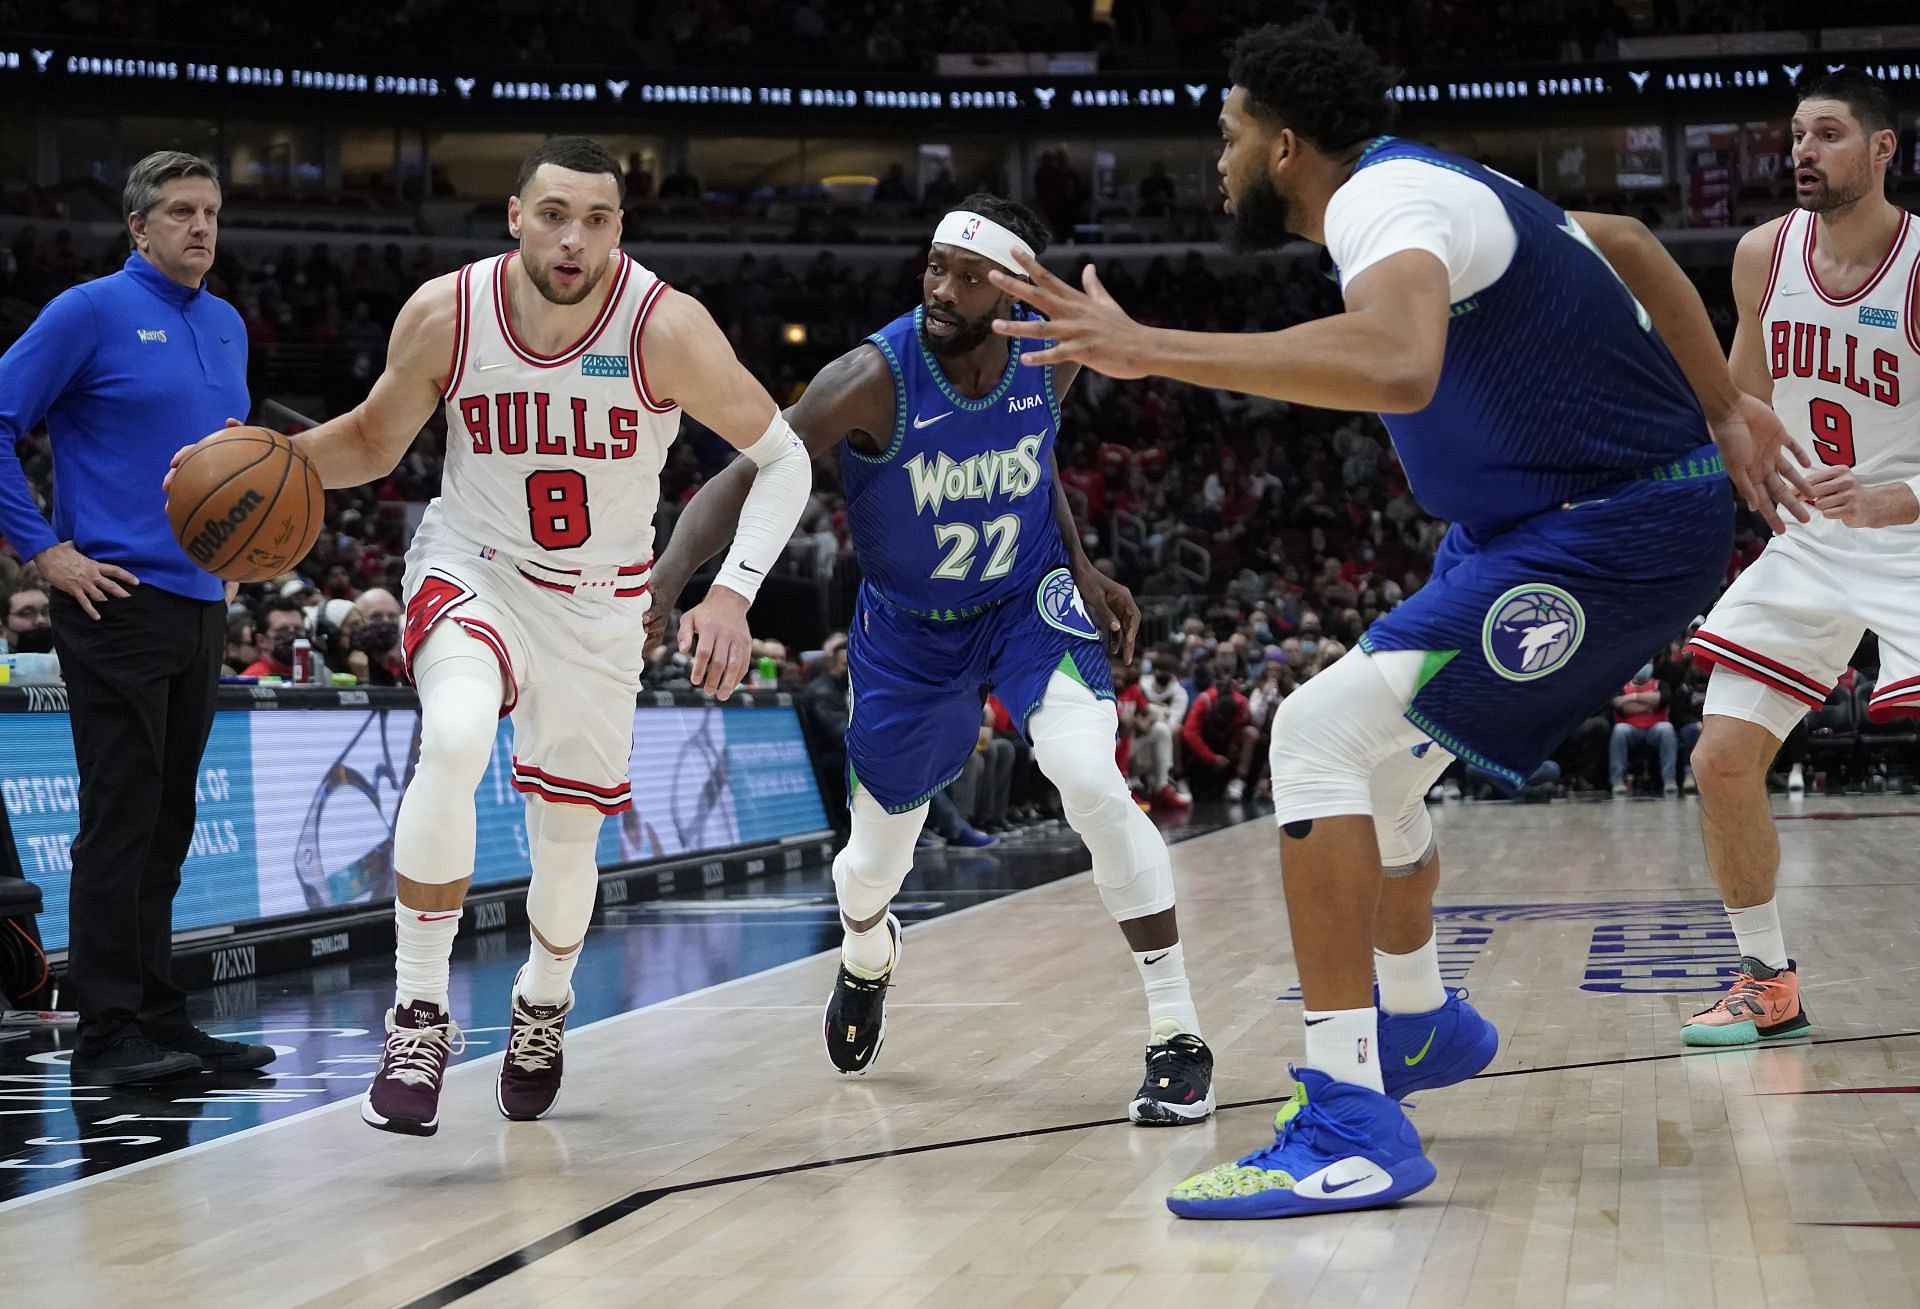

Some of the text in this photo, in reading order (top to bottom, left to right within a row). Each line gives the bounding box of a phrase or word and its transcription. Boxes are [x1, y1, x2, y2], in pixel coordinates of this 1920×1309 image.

[66, 55, 178, 80] CONNECTING
[186, 63, 218, 83] THE
[226, 66, 284, 86] WORLD
[1448, 81, 1528, 100] THROUGH
[1665, 70, 1769, 91] AAWOL.COM
[641, 85, 752, 104] CONNECTING
[759, 87, 792, 106] THE
[582, 367, 628, 377] EYEWEAR
[583, 355, 628, 368] ZENNI
[1771, 320, 1900, 408] BULLS
[459, 392, 639, 460] BULLS
[1809, 397, 1857, 469] 9
[902, 427, 1049, 518] WOLVES
[186, 489, 265, 564] Wilson
[525, 469, 592, 551] 8
[930, 513, 1021, 582] 22
[2, 775, 80, 815] OFFICI
[206, 768, 230, 801] OF
[187, 819, 240, 857] ULLS
[1578, 924, 1740, 993] CENTER
[413, 1008, 434, 1020] TWO
